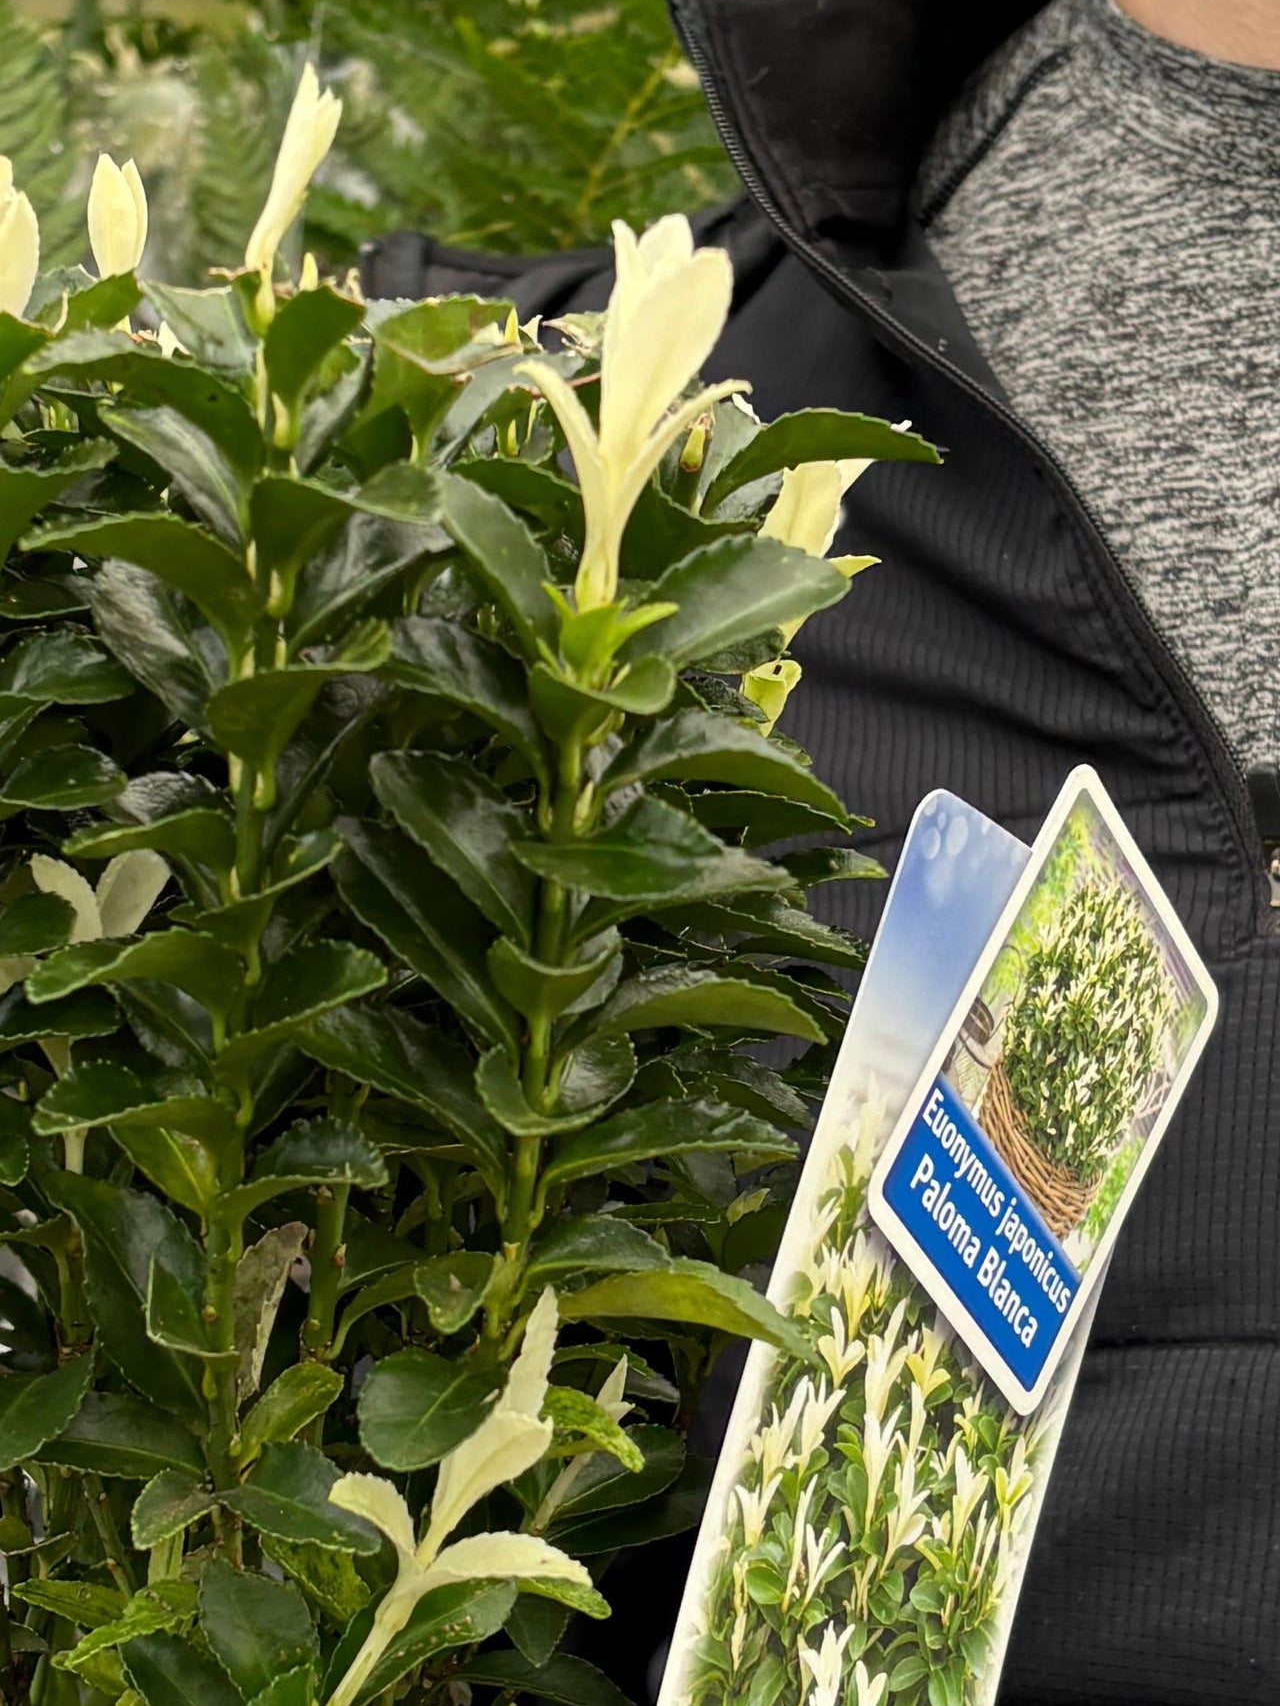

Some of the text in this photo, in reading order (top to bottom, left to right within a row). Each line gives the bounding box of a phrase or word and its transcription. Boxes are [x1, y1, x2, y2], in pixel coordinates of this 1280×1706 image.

[910, 1154, 1039, 1348] Paloma Blanca
[922, 1088, 1071, 1314] Euonymus japonicus
